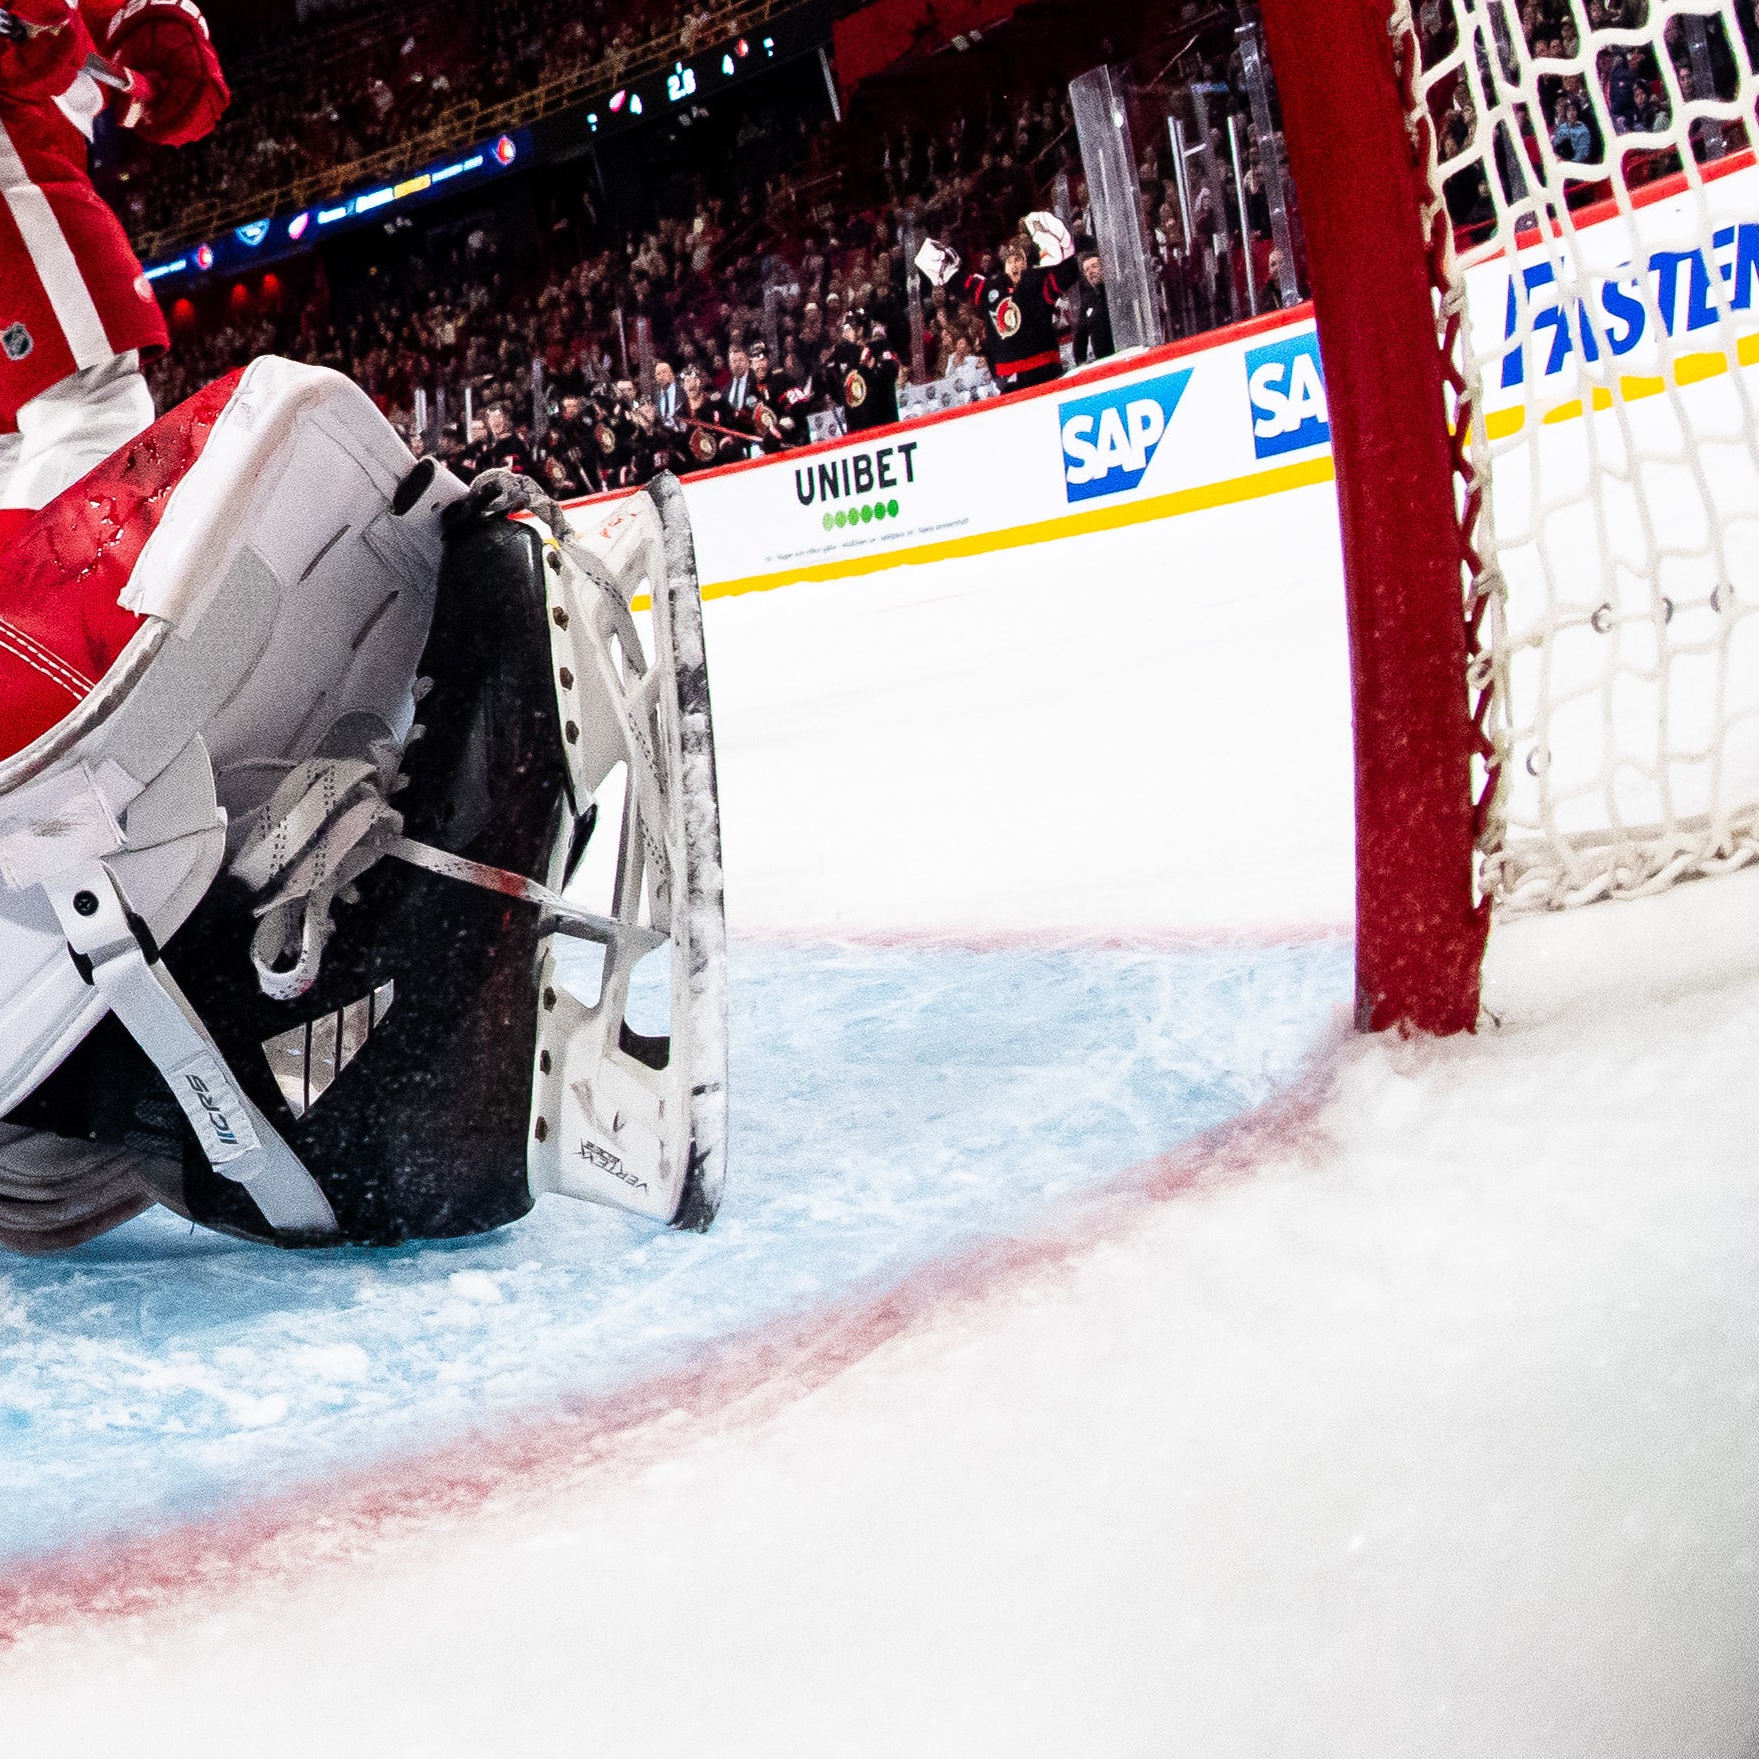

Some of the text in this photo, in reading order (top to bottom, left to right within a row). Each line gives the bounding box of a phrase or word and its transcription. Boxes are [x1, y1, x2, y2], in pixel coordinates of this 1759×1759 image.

[1248, 352, 1330, 439] SA
[795, 441, 918, 506] UNIBET
[1061, 398, 1165, 485] SAP
